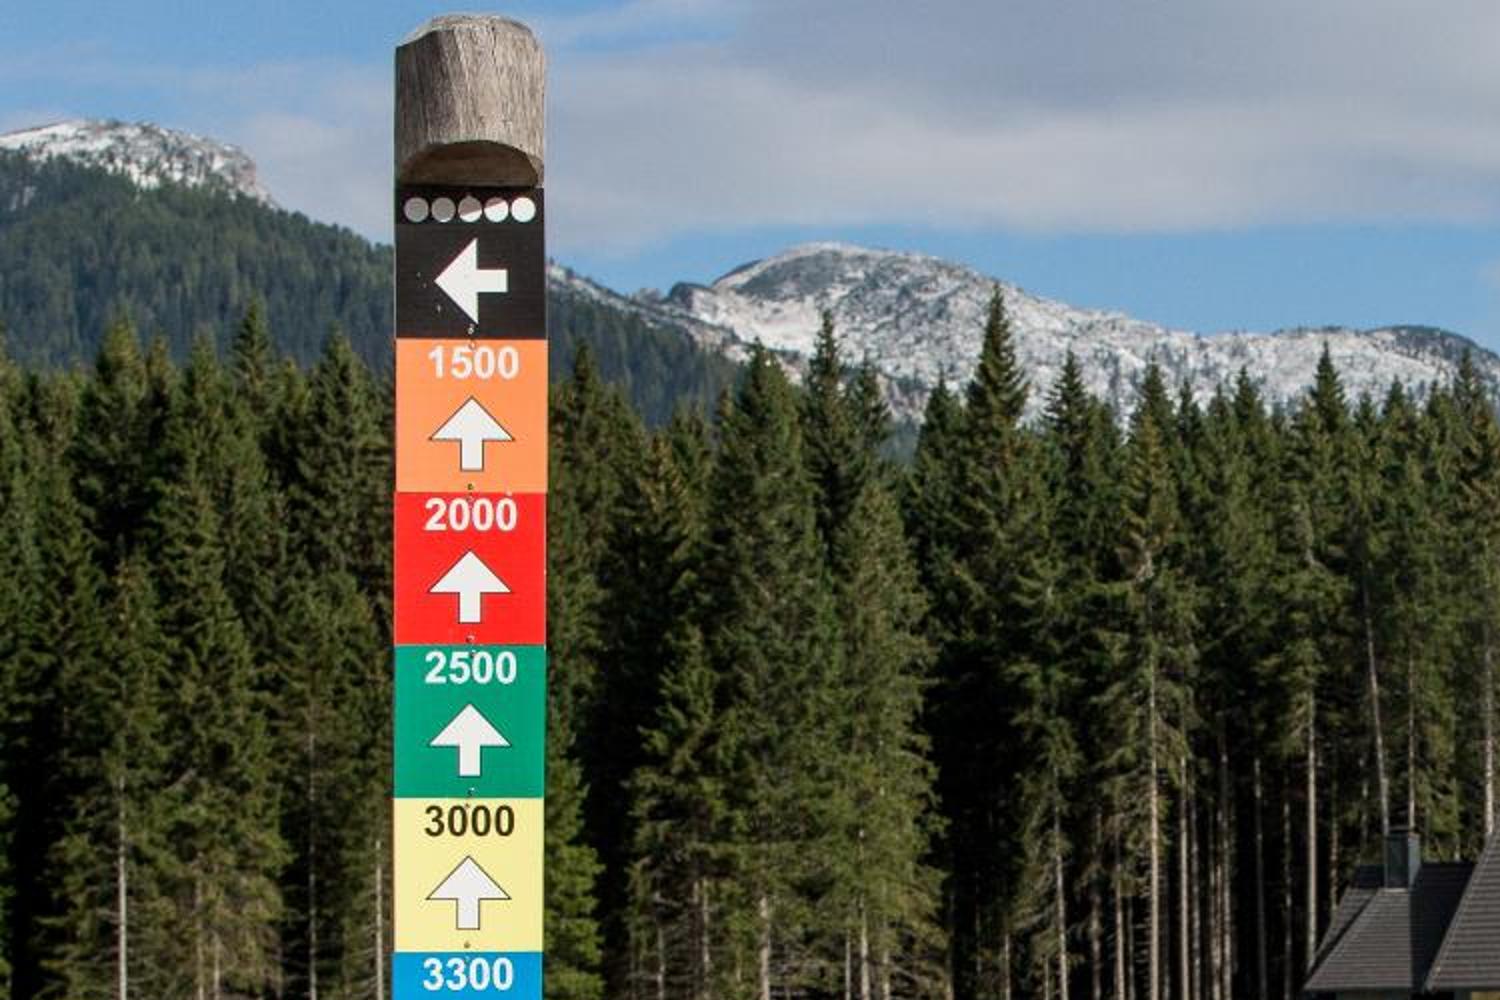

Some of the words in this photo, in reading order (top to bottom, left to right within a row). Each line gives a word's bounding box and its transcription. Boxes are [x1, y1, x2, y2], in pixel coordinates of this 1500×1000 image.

[429, 346, 519, 379] 1500
[425, 498, 517, 531] 2000
[425, 650, 517, 683] 2500
[425, 804, 515, 837] 3000
[423, 957, 513, 991] 3300
